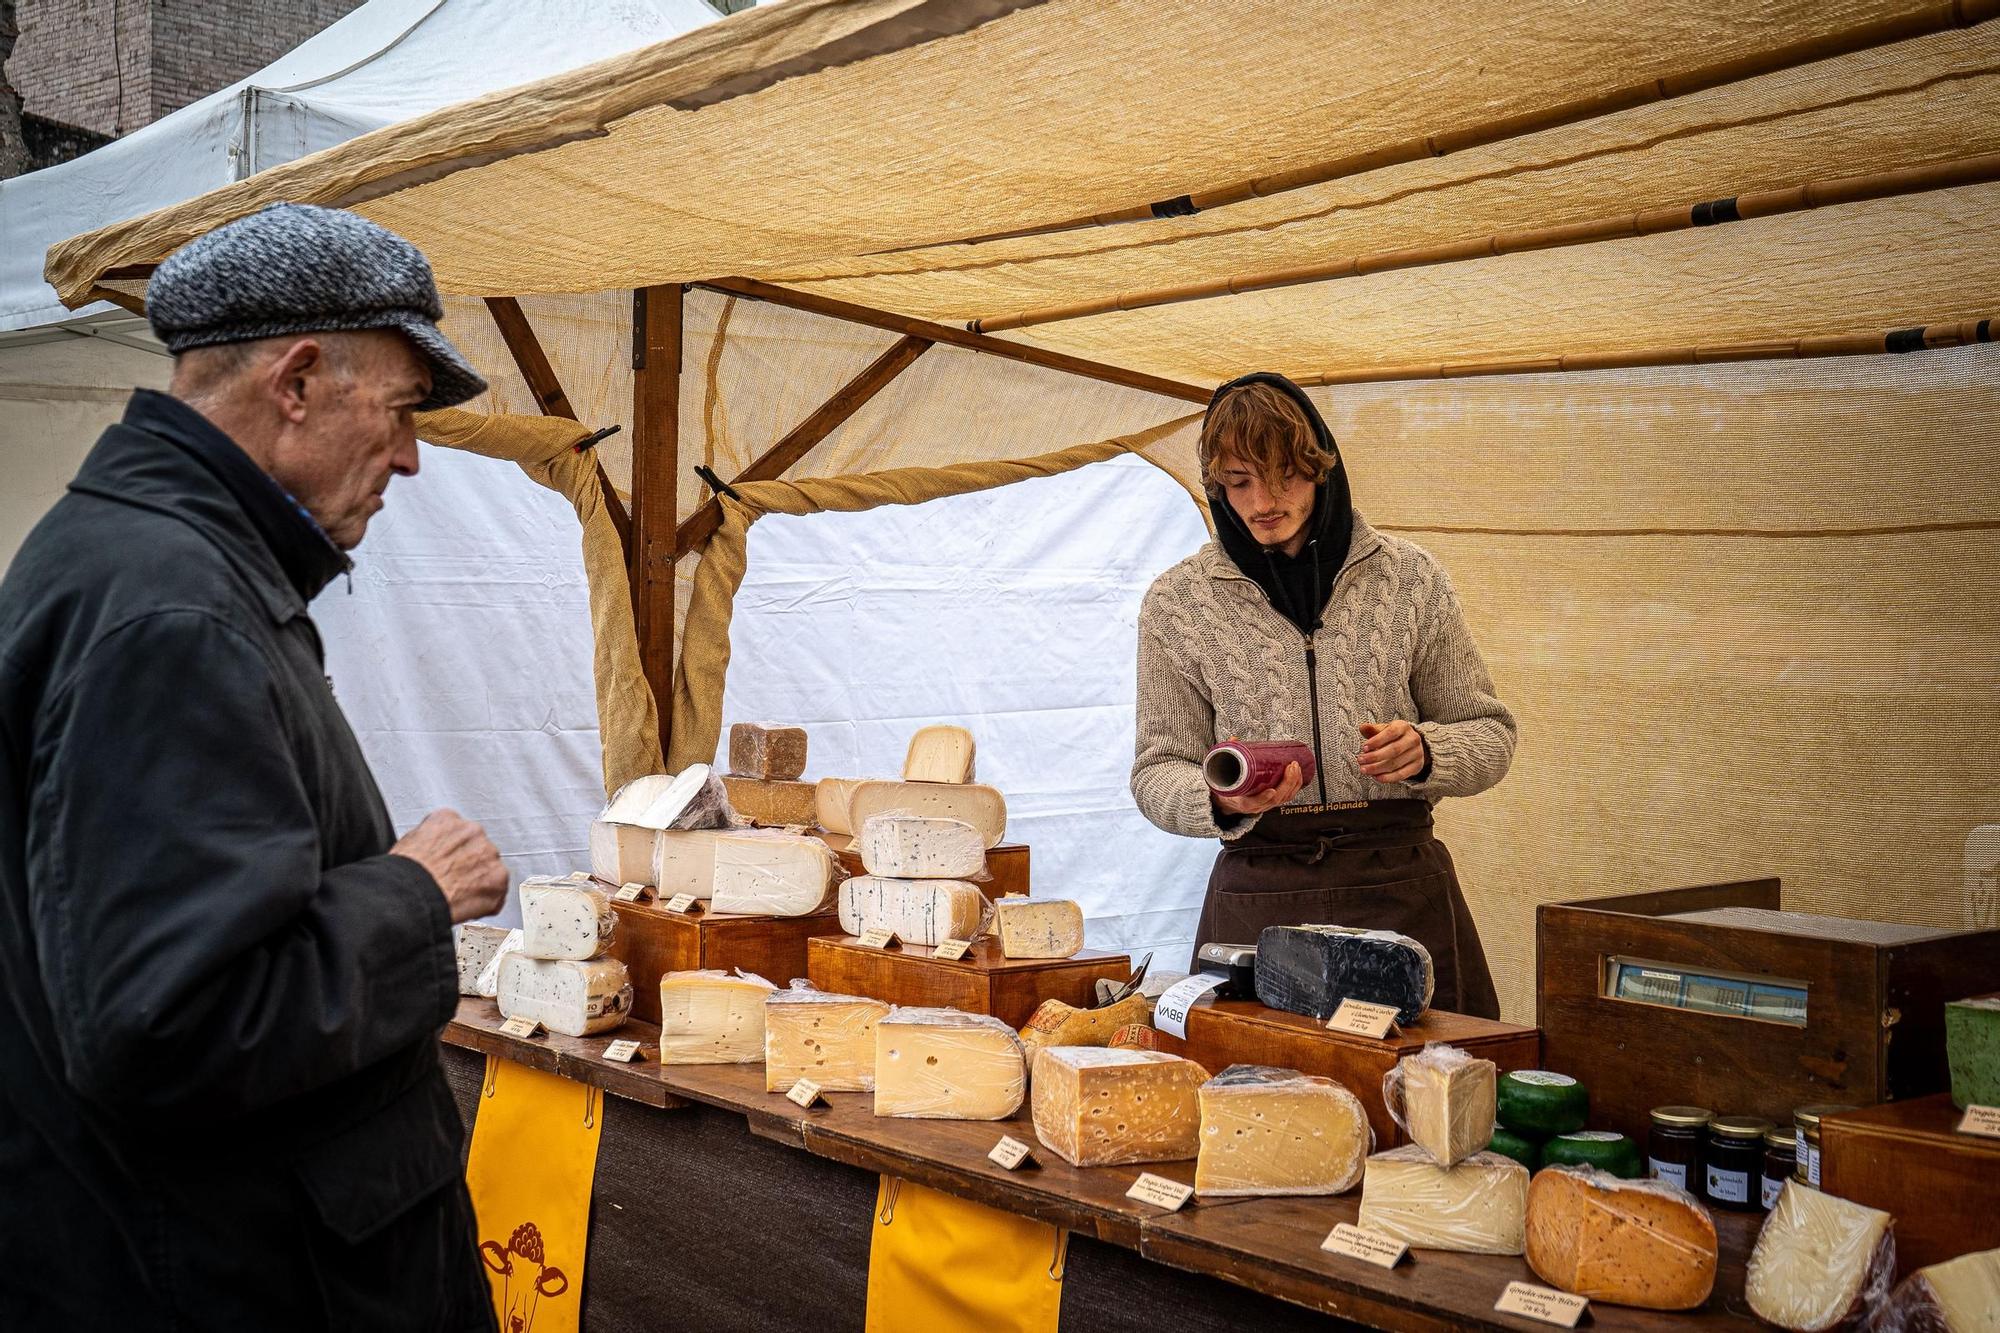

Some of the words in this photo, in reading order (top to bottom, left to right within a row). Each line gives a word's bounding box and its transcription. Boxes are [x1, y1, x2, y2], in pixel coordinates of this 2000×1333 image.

[1280, 804, 1324, 815] Formatge
[1158, 1004, 1184, 1024] BBVA
[1509, 1286, 1536, 1298] Gouda
[1536, 1291, 1557, 1301] amb
